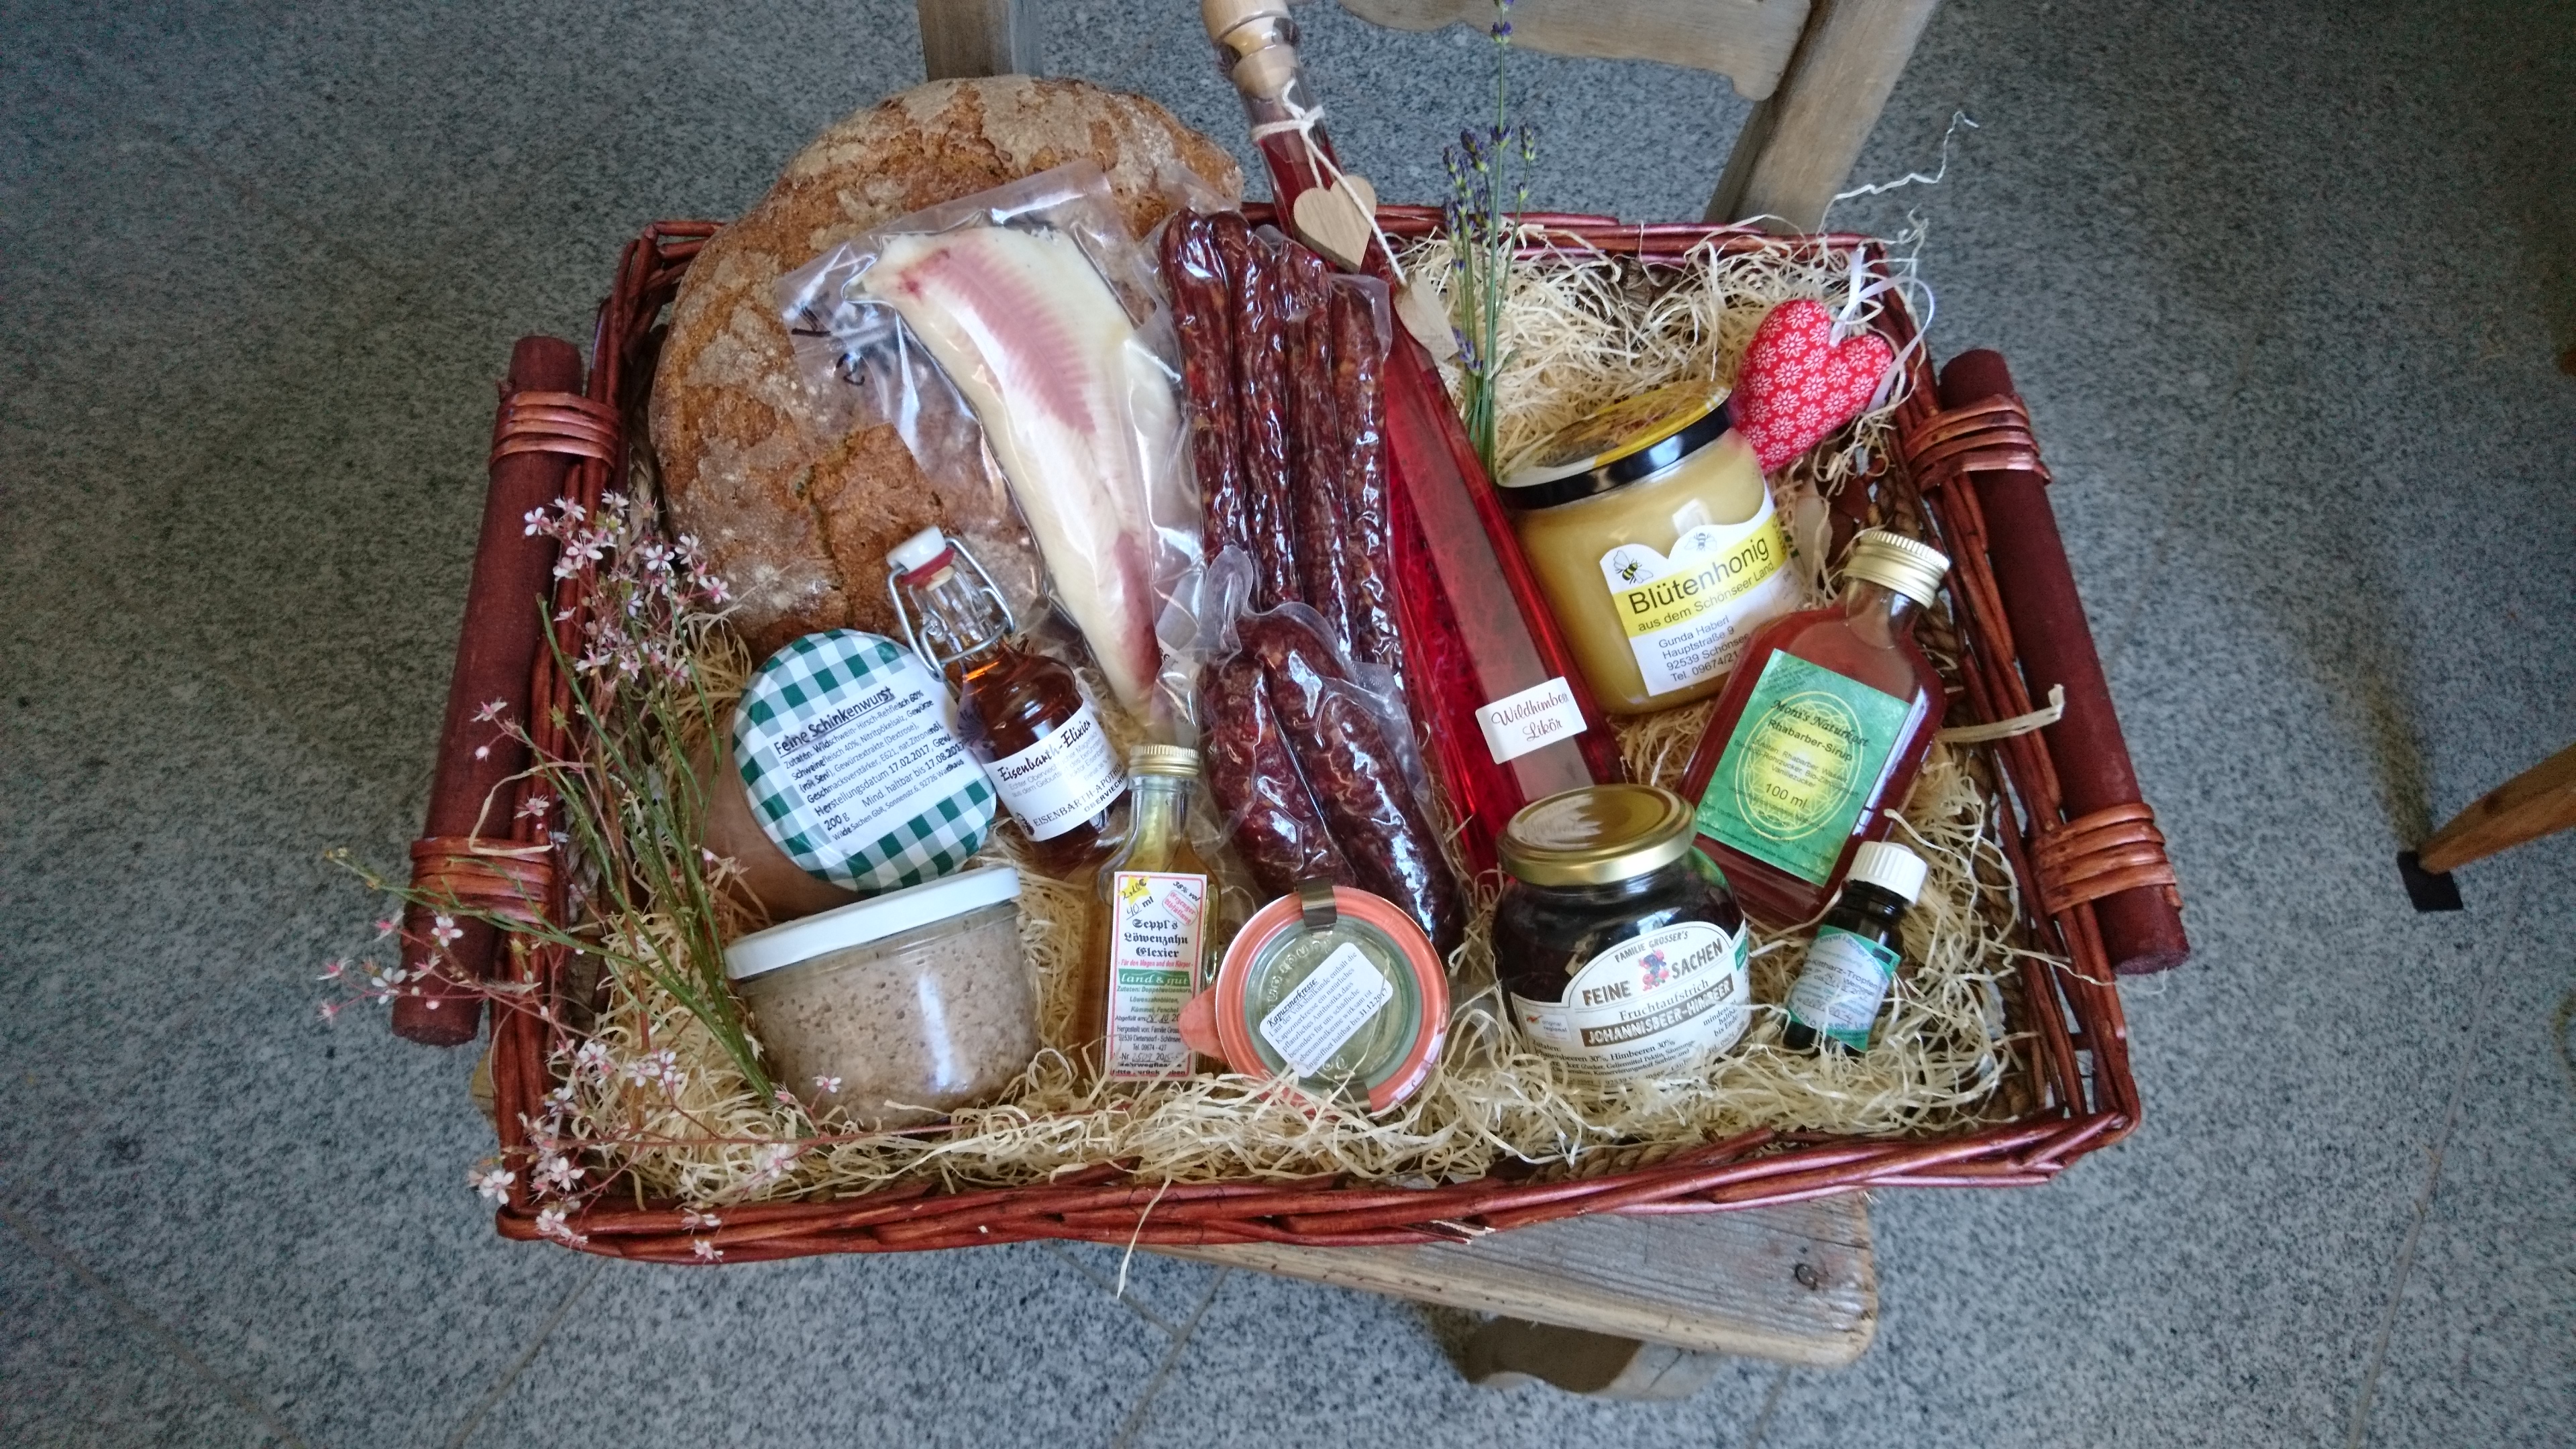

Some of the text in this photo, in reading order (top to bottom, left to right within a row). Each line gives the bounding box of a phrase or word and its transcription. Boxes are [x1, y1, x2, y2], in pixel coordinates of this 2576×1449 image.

[1628, 537, 1769, 614] Blütenhonig
[1638, 559, 1776, 632] aus dem Schönseer Land
[1658, 614, 1730, 649] Gunda Haberl
[1662, 626, 1735, 661] Hauptstraße 9
[1666, 652, 1700, 672] 92539
[1670, 668, 1690, 683] Tel.
[773, 682, 894, 757] Feine Schinkenwurst
[784, 689, 924, 769] Zutaten: Wildschwein- Hirsch-Rehfleisch 60%
[1523, 718, 1562, 741] Likör
[1770, 698, 1871, 749] Moni's Naturkost
[791, 698, 934, 781] Schweinefleisch 40%, Nitritpökelsalz, Gewürze
[798, 720, 920, 793] (mit Senf), Gewürzextrakte (Dextrose),
[998, 720, 1090, 782] Eisenbarth-Elixier
[1766, 718, 1854, 761] Rhabarber-Sirup
[806, 757, 881, 804] Geschmacksverstärker,
[879, 746, 899, 762] E621,
[813, 731, 953, 817] Herstellungsdatum 17.02.2017, Gew.
[861, 741, 966, 808] Mind. haltbar bis 17.08.2017
[1012, 790, 1022, 798] aus
[1021, 782, 1036, 796] dem
[1069, 758, 1081, 768] des
[1770, 764, 1817, 789] Vanillezucker
[832, 757, 965, 841] Wilde Sachen GbR, Sonnenstr.6, 92726 Waldhaus
[1763, 782, 1789, 801] 100
[1790, 793, 1808, 809] ml
[822, 811, 850, 831] 200 g
[1142, 896, 1154, 908] ml
[1189, 893, 1201, 902] vol
[1124, 932, 1188, 945] Löwenzahn
[1136, 947, 1179, 958] Elexier
[1615, 931, 1688, 963] FAMILIE GROSSER'S
[1121, 973, 1155, 983] land
[1165, 976, 1187, 986] gut
[1582, 981, 1632, 1006] FEINE
[1671, 938, 1723, 979] SACHEN
[1264, 975, 1320, 1028] Kapuzinerkresse:
[1268, 951, 1357, 1037] Laut der Volksheilkunde enthält die
[1274, 1002, 1321, 1045] Kapuzinerkresse
[1316, 993, 1328, 1004] ein
[1324, 966, 1356, 996] natürliches
[1341, 996, 1366, 1020] wirksam
[1619, 979, 1709, 1021] Fruchtaufstrich
[1280, 1019, 1316, 1052] pflanzliches
[1287, 987, 1361, 1059] besonders für uns schädliche
[1330, 1023, 1352, 1044] haltbar
[1542, 1024, 1567, 1033] regional
[1712, 1026, 1724, 1036] bis
[1609, 1043, 1656, 1062] Himbeeren
